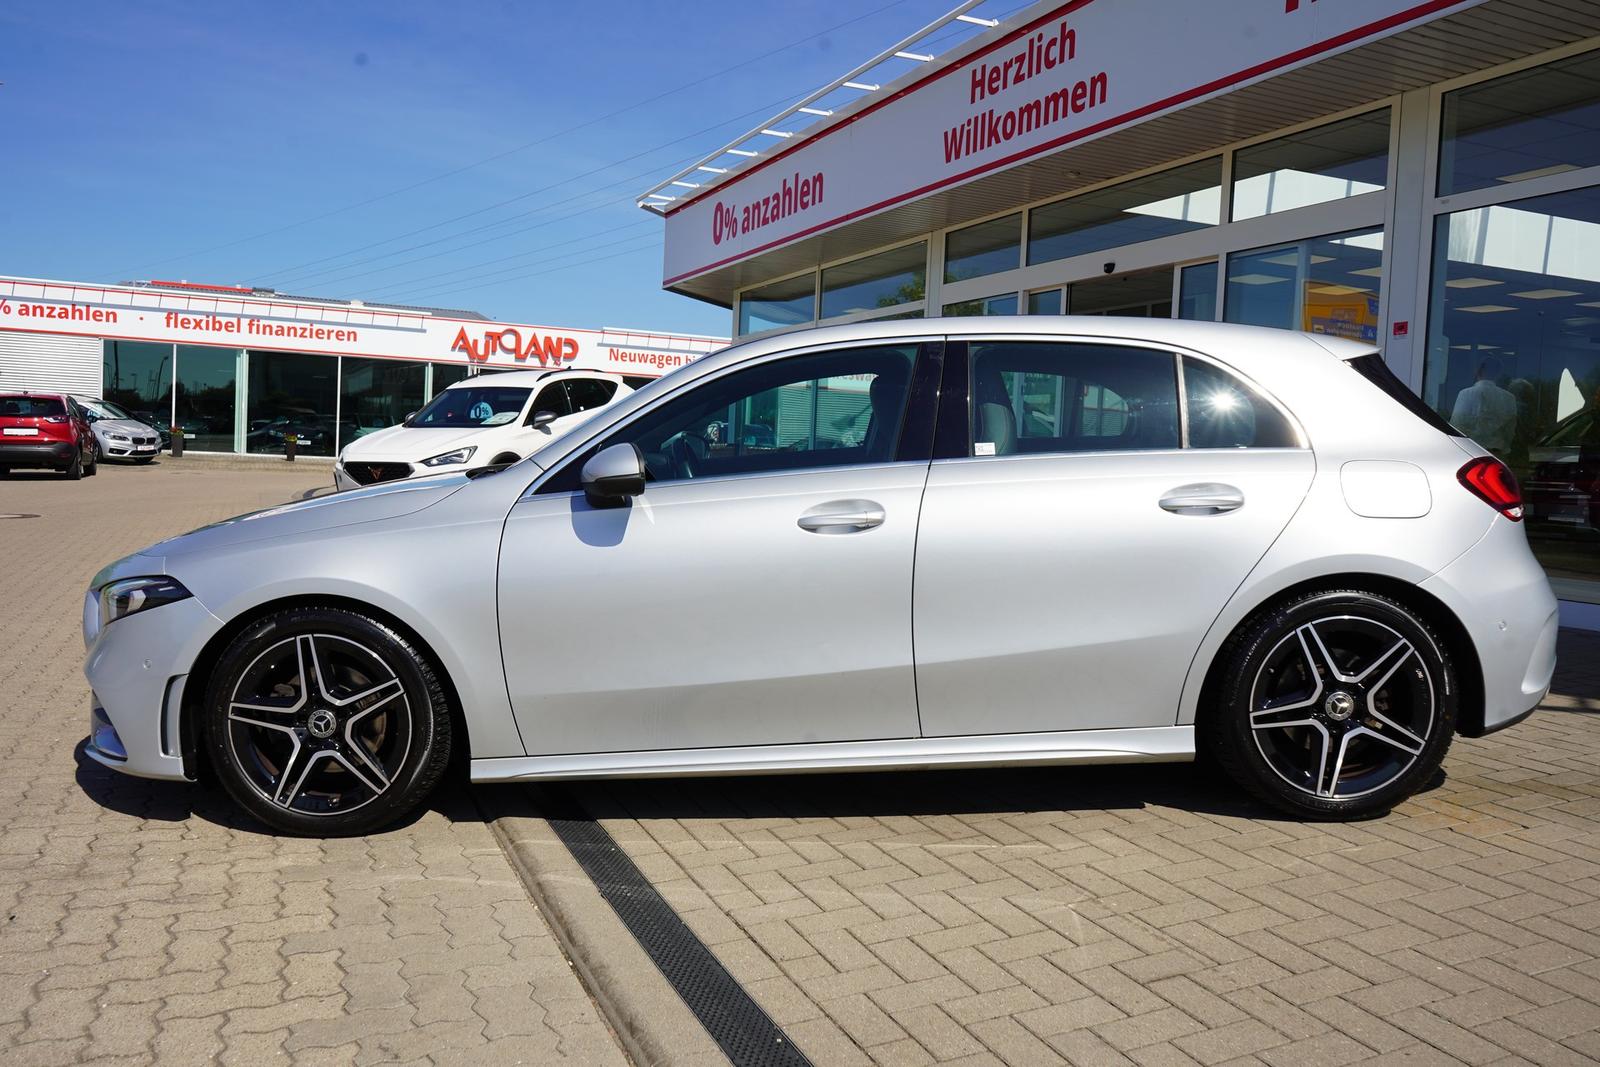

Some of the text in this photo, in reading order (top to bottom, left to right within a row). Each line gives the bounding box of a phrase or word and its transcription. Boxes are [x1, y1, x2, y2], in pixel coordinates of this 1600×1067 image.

[971, 22, 1076, 104] Herzlich
[943, 72, 1107, 164] Willkommen
[713, 172, 823, 246] 0% anzahlen
[17, 304, 118, 324] anzahlen
[165, 312, 242, 335] flexibel
[248, 319, 358, 343] finanzieren
[608, 347, 682, 369] Neuwagen
